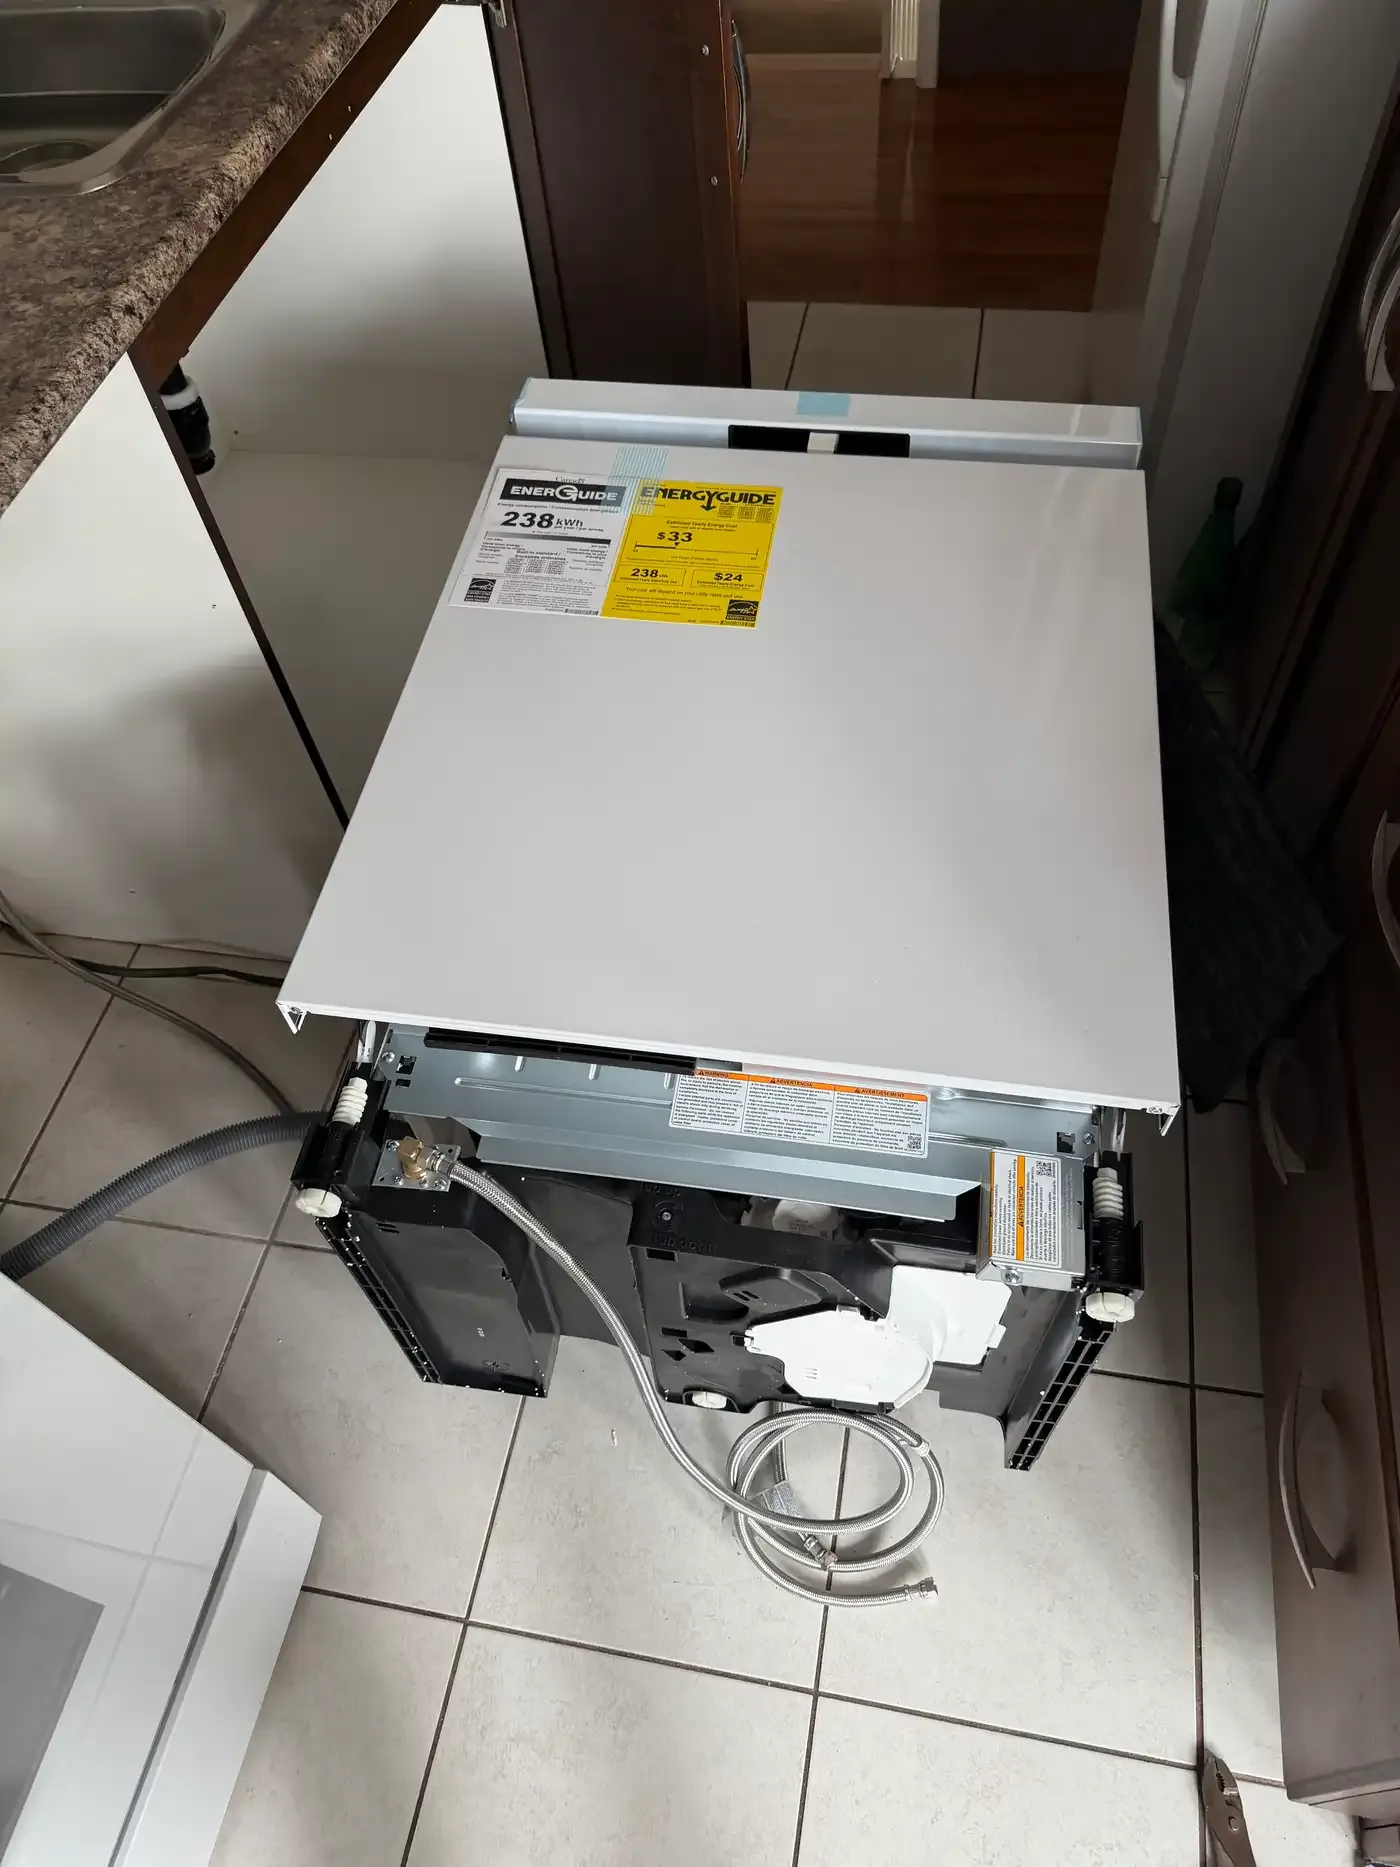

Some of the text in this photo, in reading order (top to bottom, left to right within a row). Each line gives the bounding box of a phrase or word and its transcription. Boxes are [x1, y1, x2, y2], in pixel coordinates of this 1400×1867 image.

[510, 485, 618, 501] ENERGUIDE
[641, 487, 776, 505] ENERGYGUIDE
[500, 511, 555, 528] 238
[556, 518, 583, 527] kWh
[657, 531, 693, 543] $33
[630, 568, 659, 578] 238
[714, 572, 743, 582] $24
[776, 1079, 813, 1087] ADVERTENCIA
